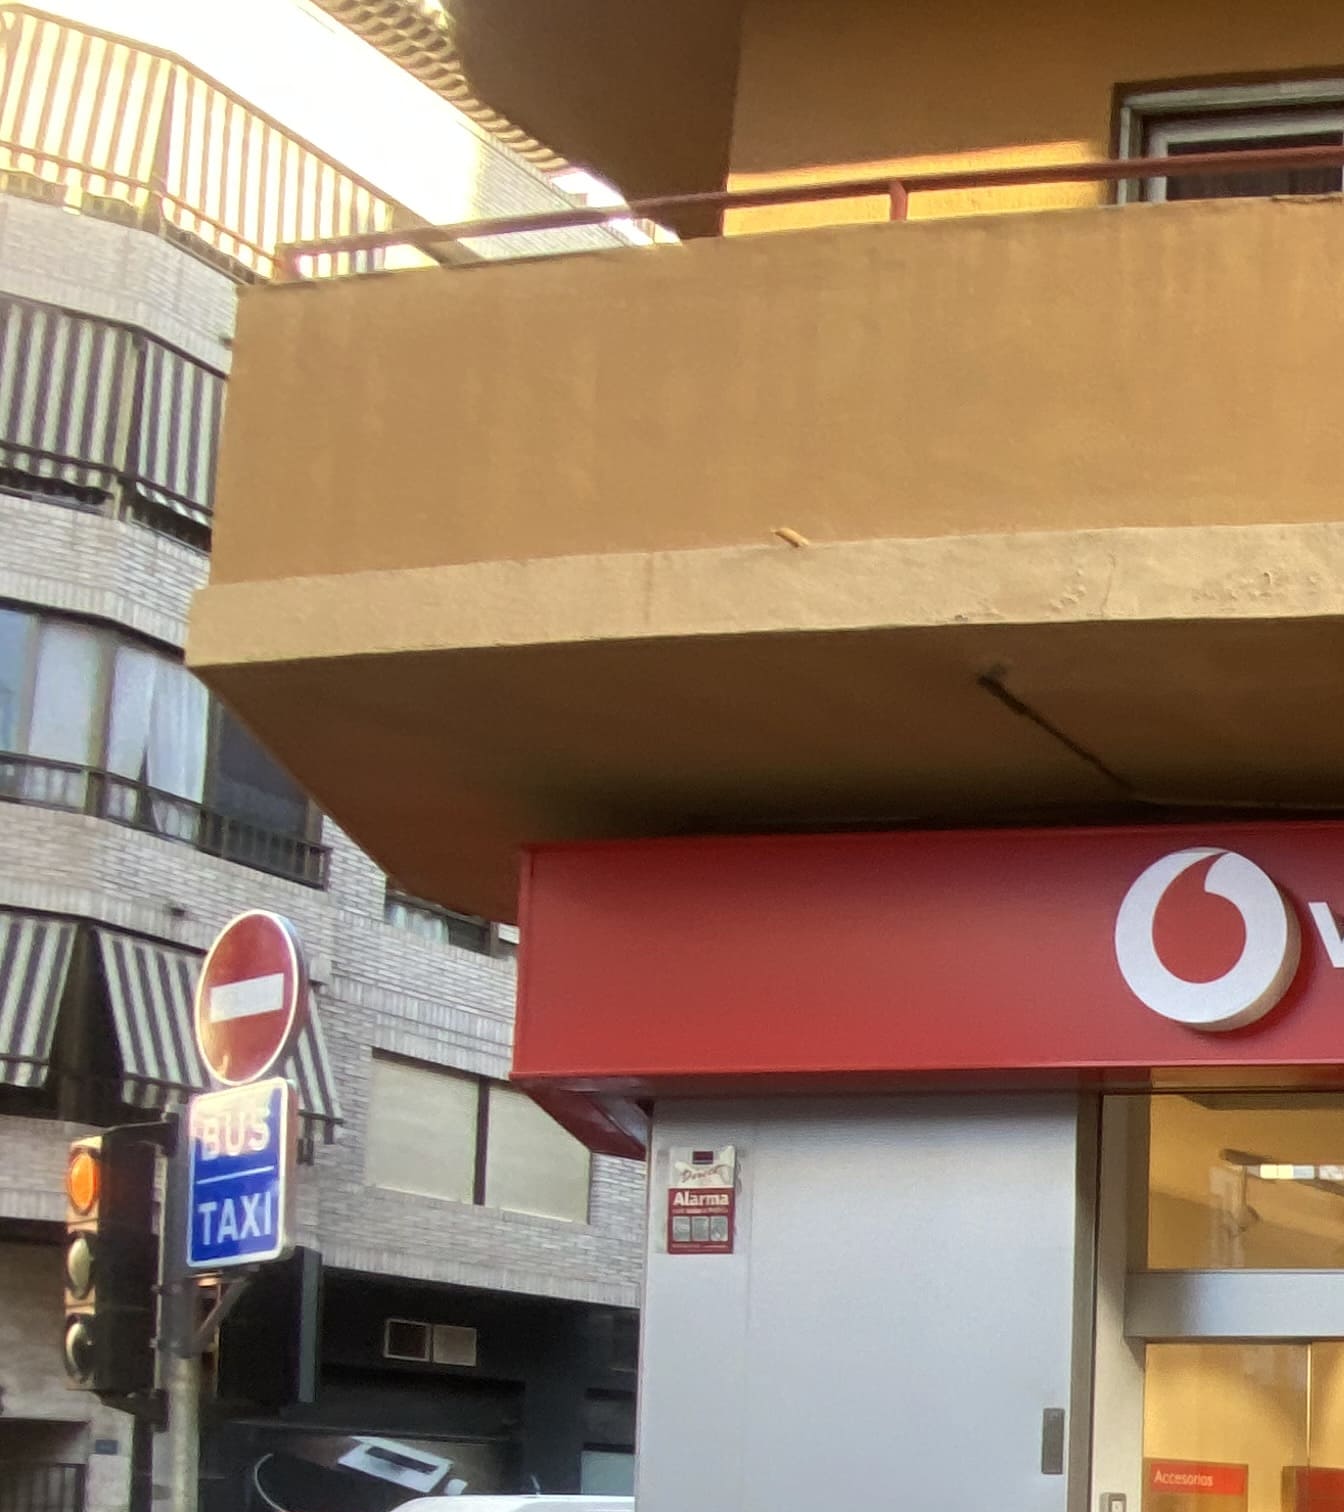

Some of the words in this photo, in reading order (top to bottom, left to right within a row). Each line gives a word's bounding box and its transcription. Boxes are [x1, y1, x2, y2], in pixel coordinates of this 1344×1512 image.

[202, 1109, 270, 1161] BUS
[197, 1191, 271, 1245] TAXI
[673, 1191, 730, 1206] Alarma
